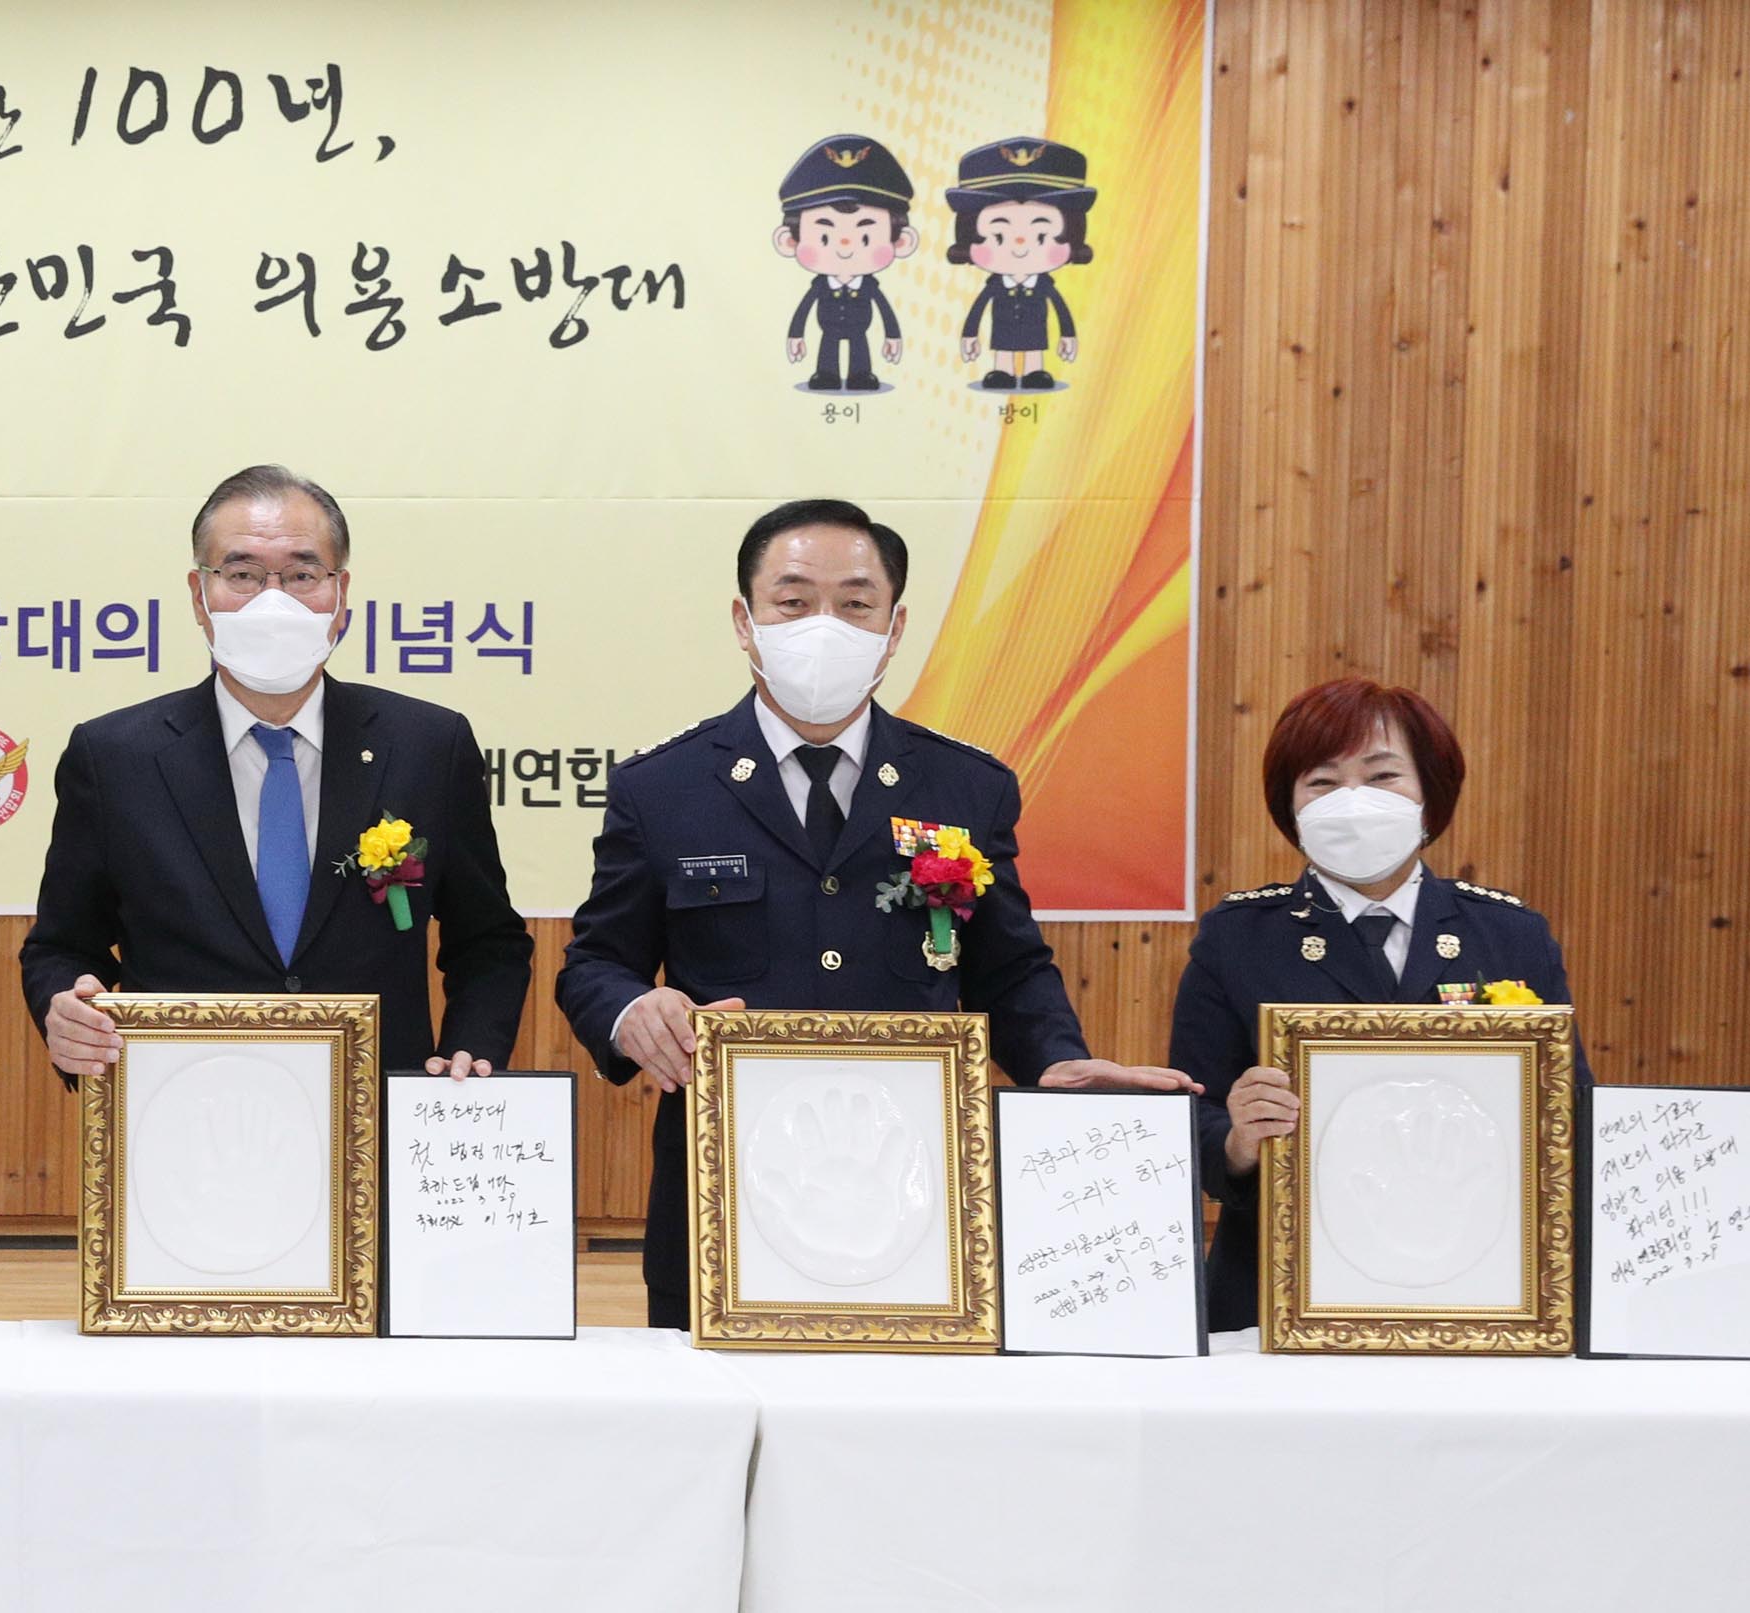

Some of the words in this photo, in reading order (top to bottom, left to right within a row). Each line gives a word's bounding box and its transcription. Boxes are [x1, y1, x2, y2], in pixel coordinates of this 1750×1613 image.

[70, 61, 397, 165] 100년,
[253, 240, 687, 352] 의용소방대
[821, 402, 860, 424] 용이
[998, 403, 1038, 425] 방이
[413, 1099, 507, 1132] 의용소방대
